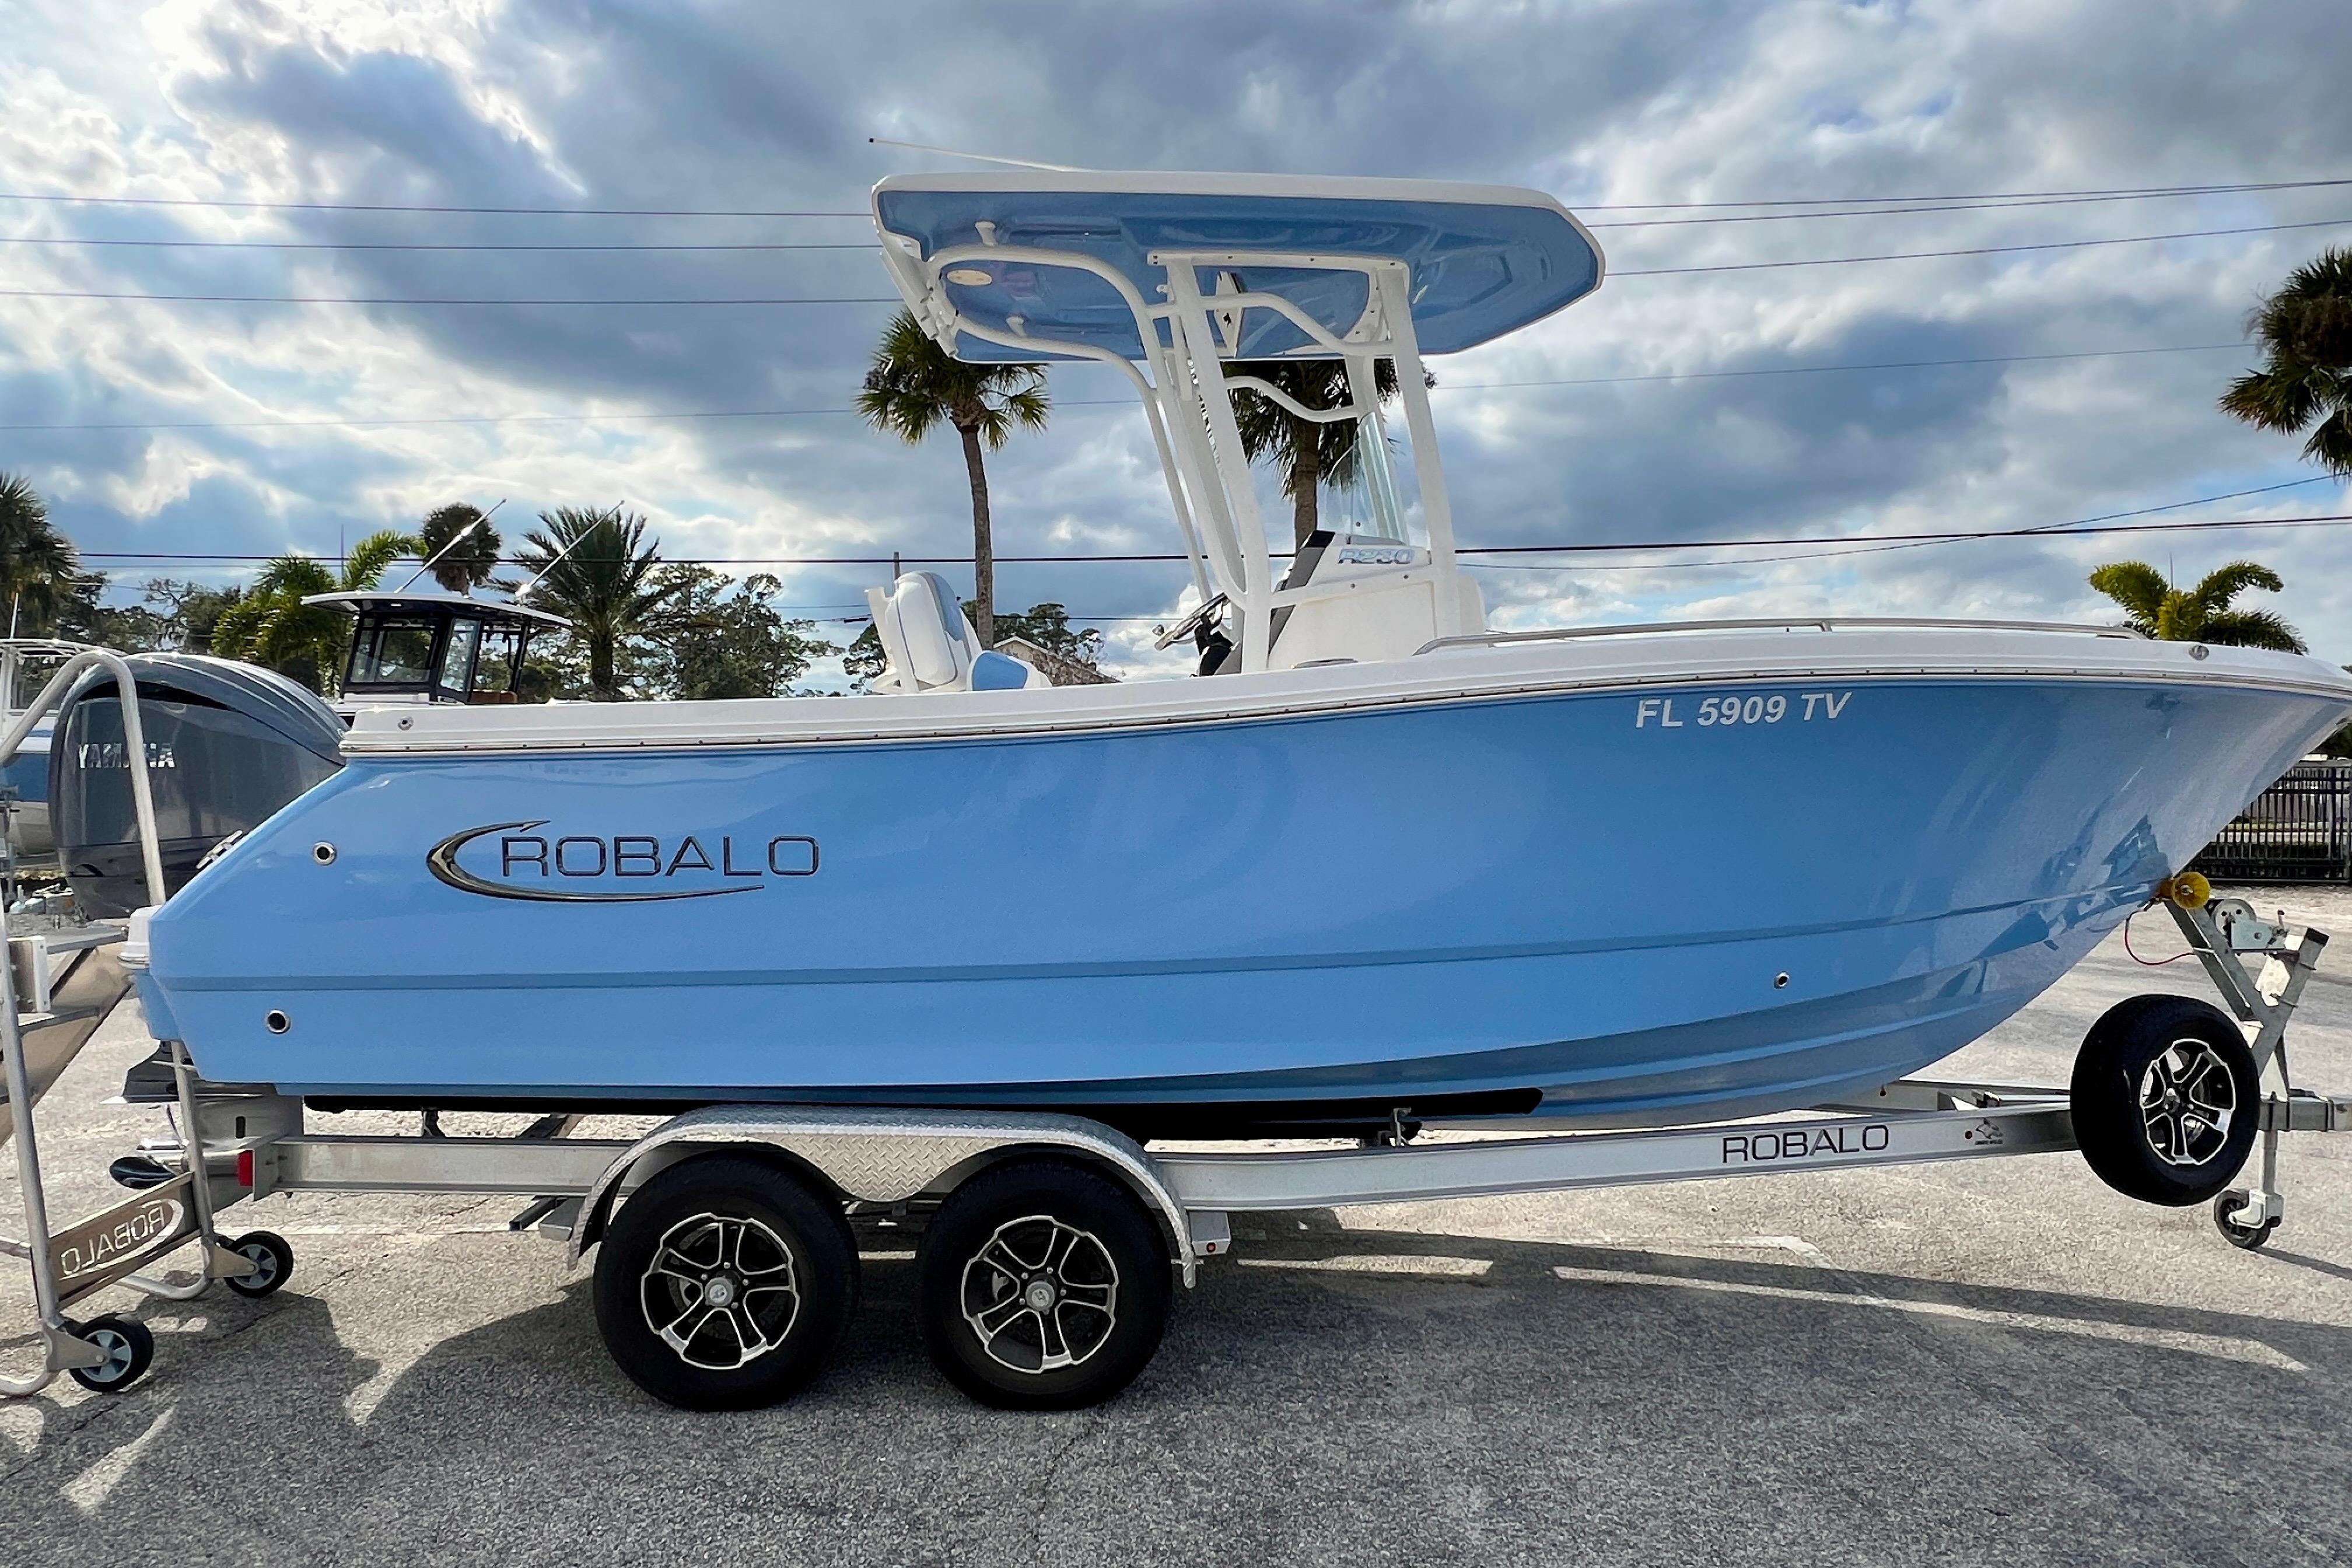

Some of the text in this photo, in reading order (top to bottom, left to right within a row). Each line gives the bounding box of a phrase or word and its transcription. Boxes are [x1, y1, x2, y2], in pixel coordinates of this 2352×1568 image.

[1635, 692, 1853, 728] FL 5909 TV
[79, 743, 175, 768] YAMHA
[501, 835, 820, 877] ROBALO
[1722, 1125, 1889, 1164] ROBALO
